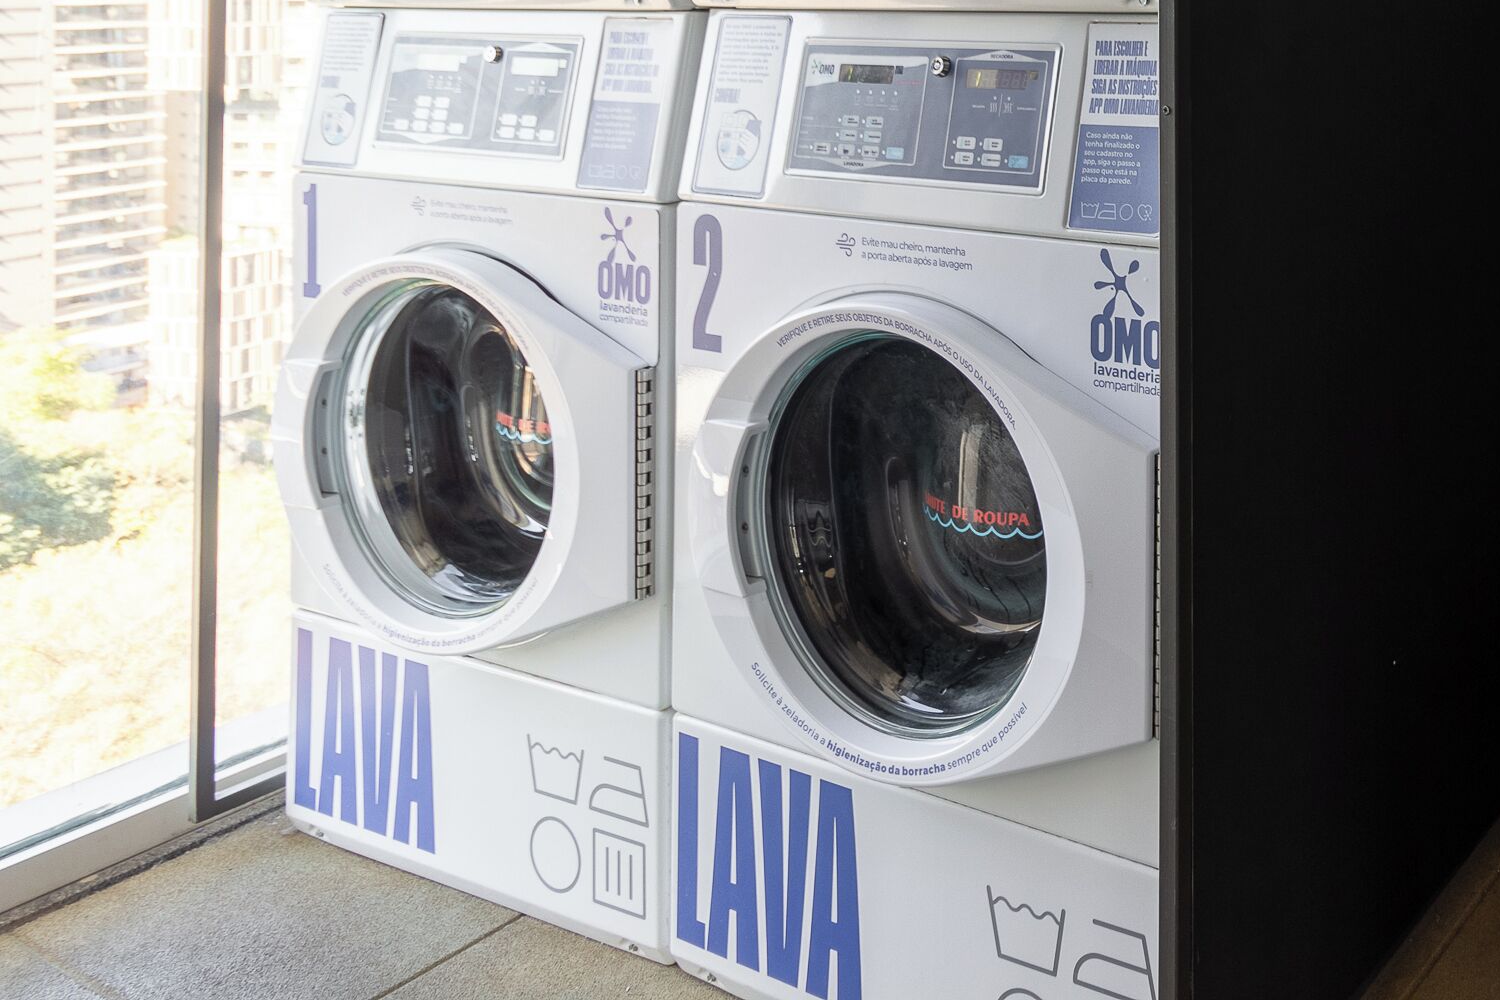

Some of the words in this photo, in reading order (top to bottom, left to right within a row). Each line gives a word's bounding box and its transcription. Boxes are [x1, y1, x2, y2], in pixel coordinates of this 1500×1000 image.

[1095, 40, 1113, 57] PARA
[1113, 40, 1144, 57] ESCOLHER
[1144, 40, 1149, 57] E
[819, 63, 835, 75] OMO
[1093, 59, 1119, 76] LIBERAR
[1119, 60, 1125, 76] A
[1125, 57, 1158, 78] MÁQUINA
[1091, 78, 1107, 95] SIGA
[1107, 78, 1118, 95] AS
[1118, 76, 1158, 98] INSTRUÇÕES
[1089, 97, 1103, 114] APP
[1103, 98, 1120, 114] OMO
[1120, 98, 1159, 116] LAVANDERIA
[1085, 140, 1104, 148] tenha
[1104, 141, 1135, 149] finalizado
[1086, 131, 1102, 139] Caso
[1102, 132, 1120, 140] ainda
[1083, 158, 1097, 166] app,
[1097, 158, 1111, 167] siga
[1117, 160, 1136, 168] passo
[1096, 150, 1124, 158] cadastro
[1080, 175, 1098, 184] placa
[1108, 177, 1132, 185] parede.
[1081, 167, 1101, 175] passo
[1101, 168, 1114, 176] que
[1114, 168, 1128, 176] está
[302, 183, 321, 298] 1
[862, 236, 880, 247] Evite
[880, 240, 899, 250] mau
[899, 241, 925, 254] cheiro,
[925, 245, 966, 257] mantenha
[867, 251, 888, 262] porta
[888, 253, 913, 264] aberta
[913, 256, 932, 267] após
[932, 259, 938, 267] a
[938, 258, 973, 271] lavagem
[598, 260, 651, 305] OMO
[691, 213, 723, 354] 2
[599, 300, 648, 317] lavanderia
[776, 322, 809, 348] VERIFIQUE
[808, 321, 814, 330] E
[812, 314, 836, 328] RETIRE
[835, 313, 853, 323] SEUS
[853, 313, 883, 325] OBJETOS
[883, 317, 895, 327] DA
[895, 320, 933, 344] BORRACHA
[933, 338, 952, 357] APÓS
[952, 351, 959, 360] O
[959, 356, 974, 373] USO
[974, 369, 985, 384] DA
[1090, 313, 1160, 370] OMO
[1093, 362, 1160, 384] lavanderia
[1093, 379, 1160, 397] compartilhada
[952, 504, 969, 521] DE
[973, 509, 1031, 526] ROUPA
[751, 662, 778, 699] Solicite
[782, 703, 820, 741] zeladoria
[820, 736, 826, 745] a
[826, 739, 887, 773] higienização
[888, 765, 901, 776] da
[901, 762, 947, 776] borracha
[947, 748, 982, 770] sempre
[981, 736, 999, 753] que
[998, 702, 1028, 741] possível
[294, 626, 437, 855] LAVA
[676, 731, 862, 1000] LAVA
